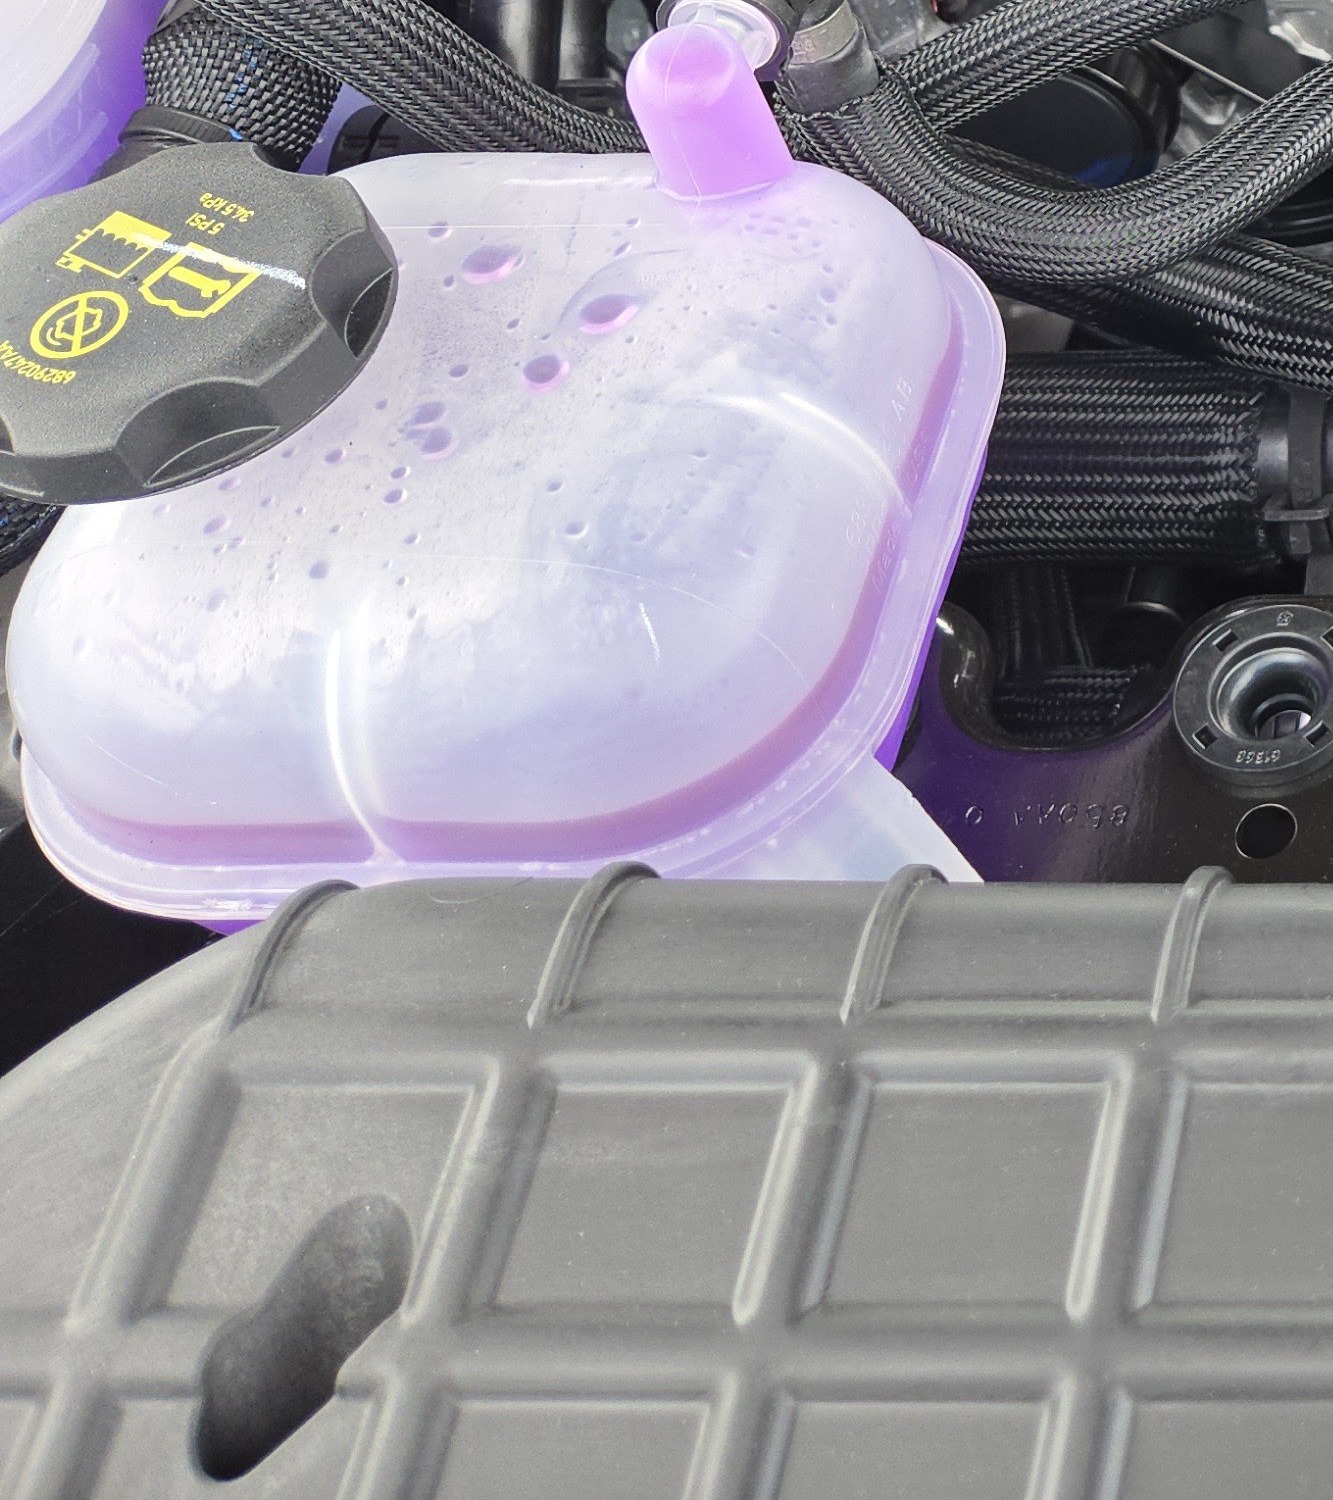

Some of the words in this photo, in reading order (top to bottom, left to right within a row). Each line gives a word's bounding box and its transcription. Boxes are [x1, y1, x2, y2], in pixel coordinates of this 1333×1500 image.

[199, 192, 228, 211] kPa
[185, 212, 216, 231] PSI
[207, 222, 225, 235] 5
